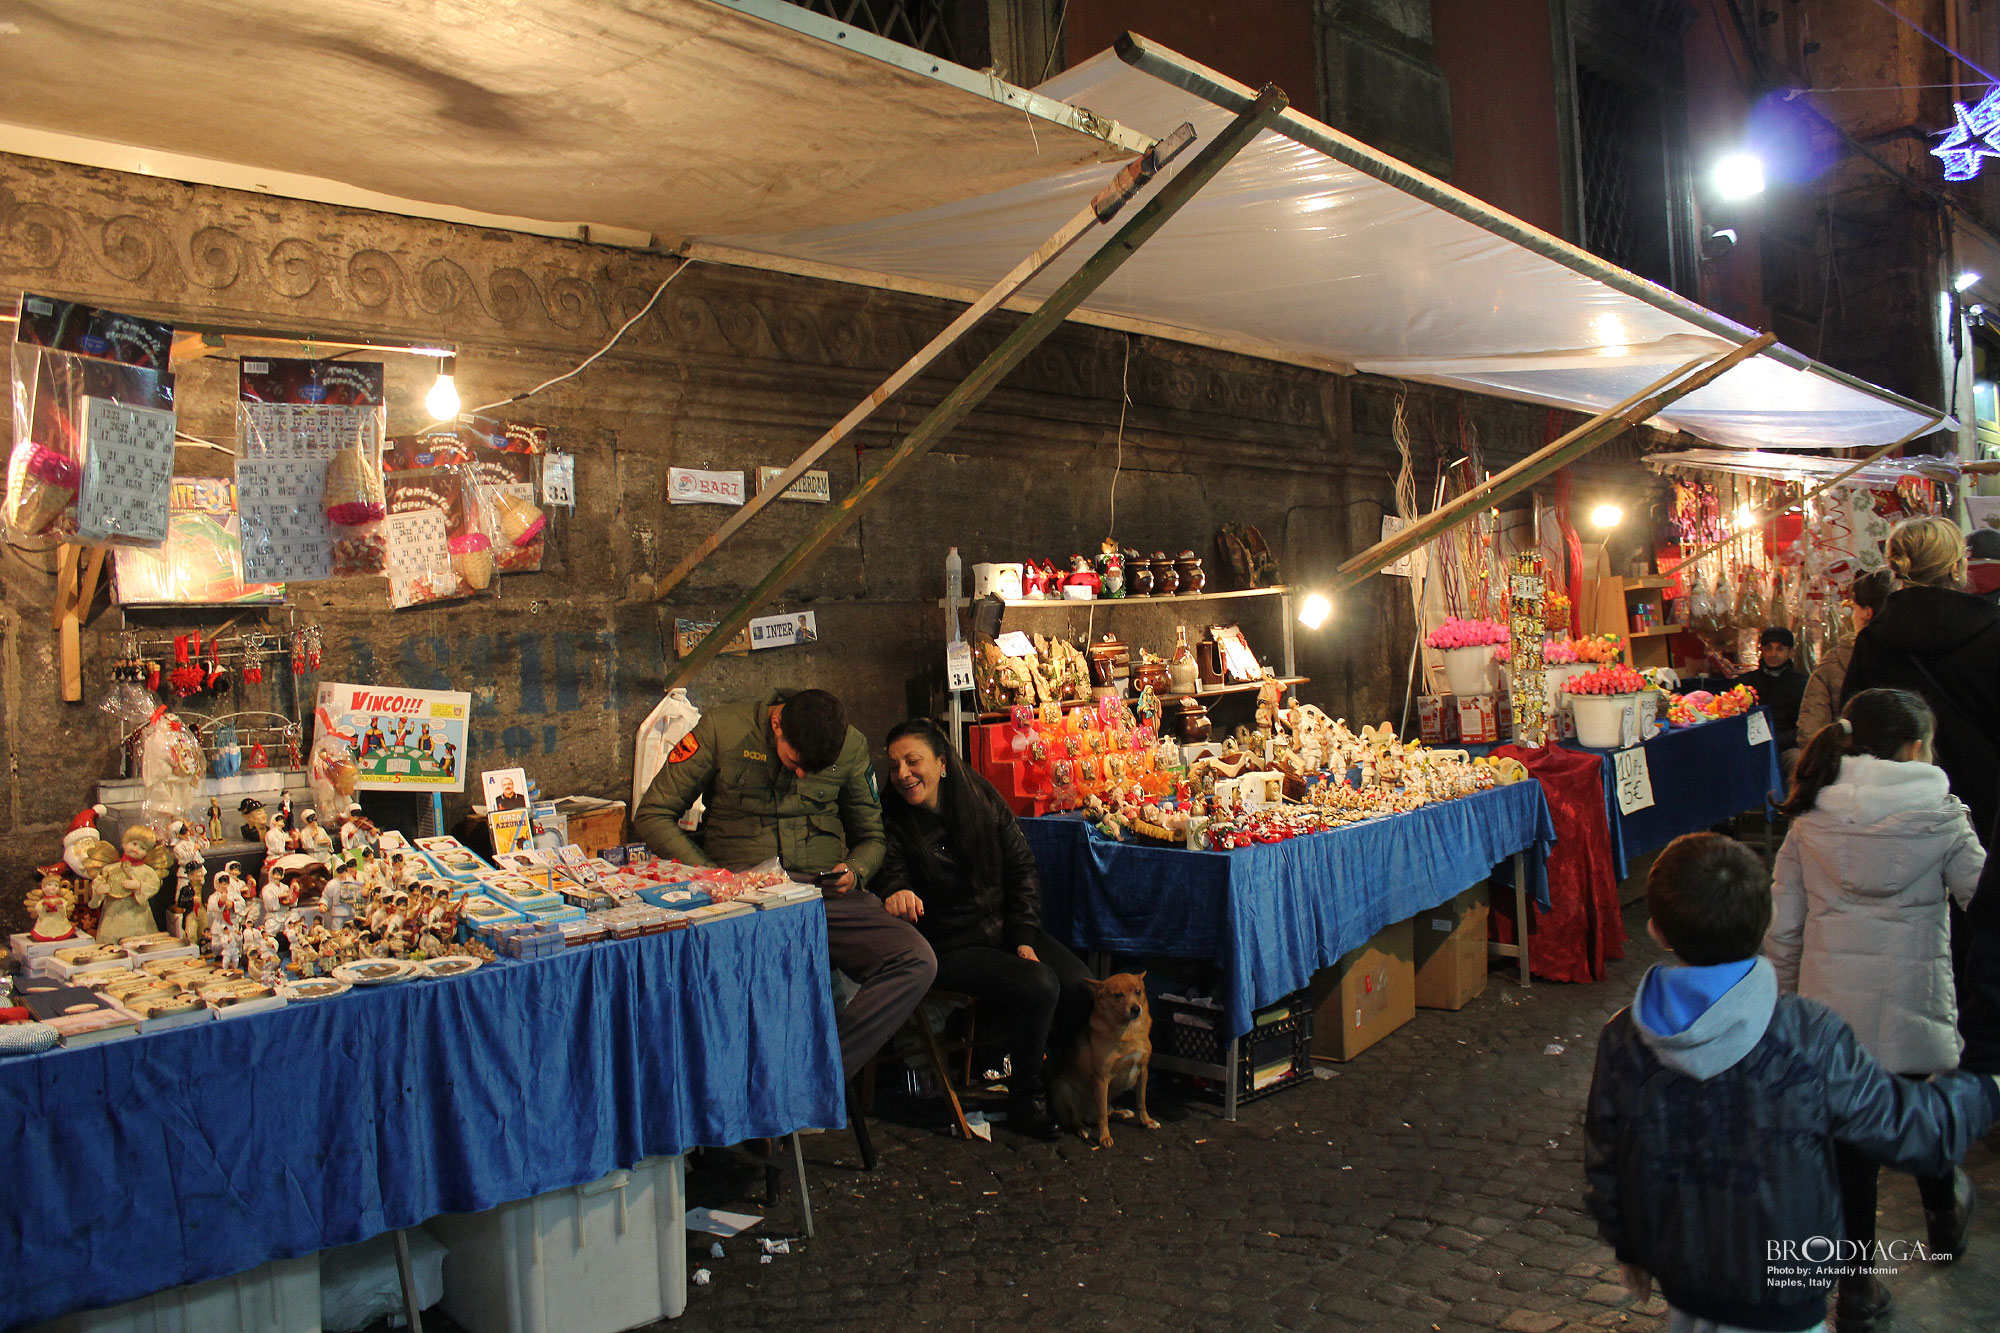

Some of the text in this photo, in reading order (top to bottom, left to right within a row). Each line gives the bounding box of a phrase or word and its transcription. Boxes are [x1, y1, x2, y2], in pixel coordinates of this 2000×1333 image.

[327, 366, 374, 390] Tombola
[700, 480, 739, 496] BARI
[787, 476, 828, 494] STERDAM
[395, 486, 451, 512] Tombola
[766, 623, 794, 639] INTER
[954, 673, 970, 686] 34
[351, 692, 424, 714] VINCO!!!
[1617, 753, 1632, 781] 10
[393, 772, 402, 784] 5
[496, 820, 527, 829] AZZURRI
[498, 814, 522, 822] FORZA
